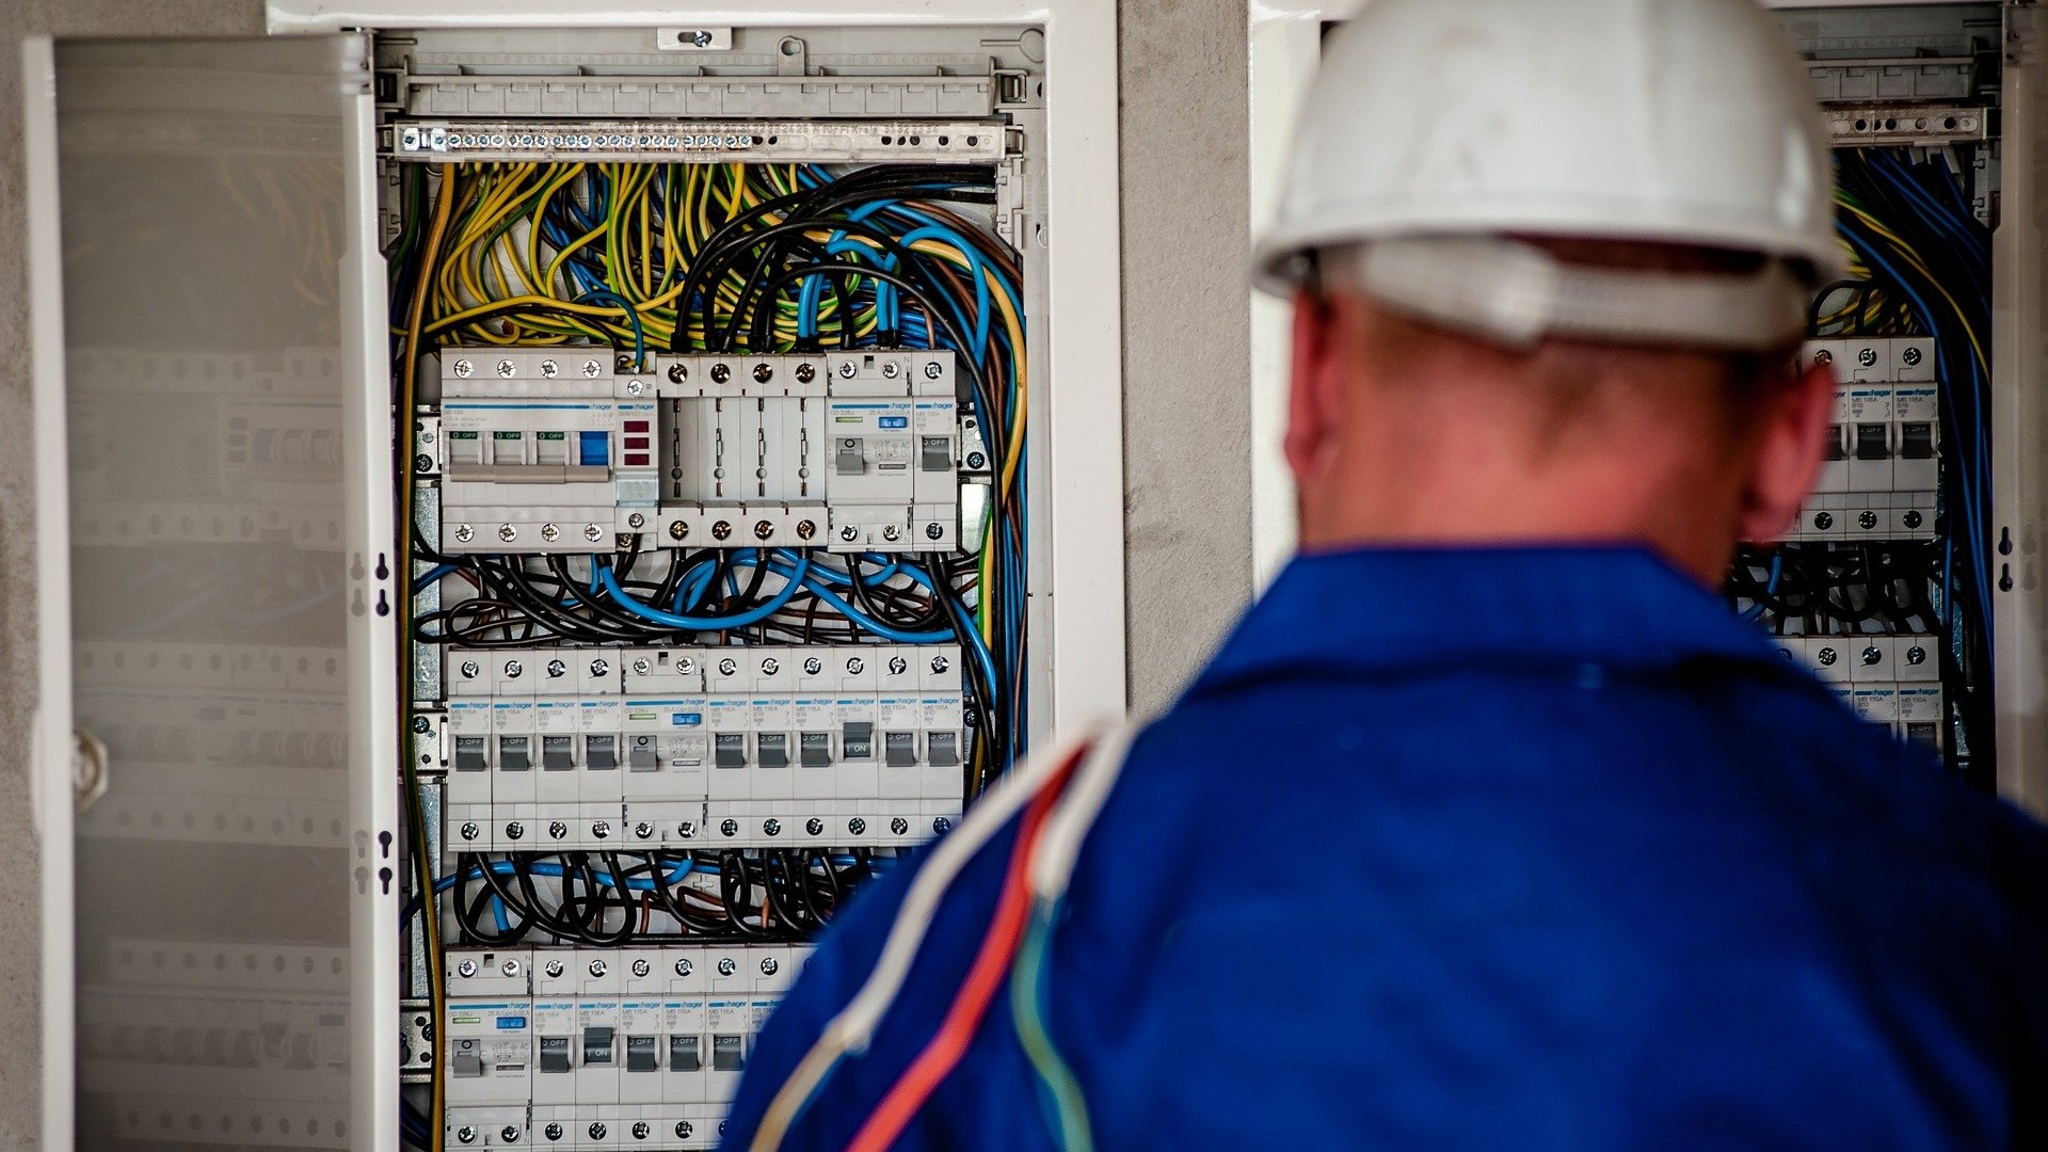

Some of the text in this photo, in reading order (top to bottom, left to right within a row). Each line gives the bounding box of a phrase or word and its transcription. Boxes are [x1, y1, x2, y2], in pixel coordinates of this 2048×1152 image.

[1871, 389, 1891, 397] hager
[1915, 389, 1936, 397] hager
[934, 402, 953, 410] hager
[1918, 688, 1939, 696] hager
[555, 701, 575, 709] hager
[940, 697, 959, 705] hager
